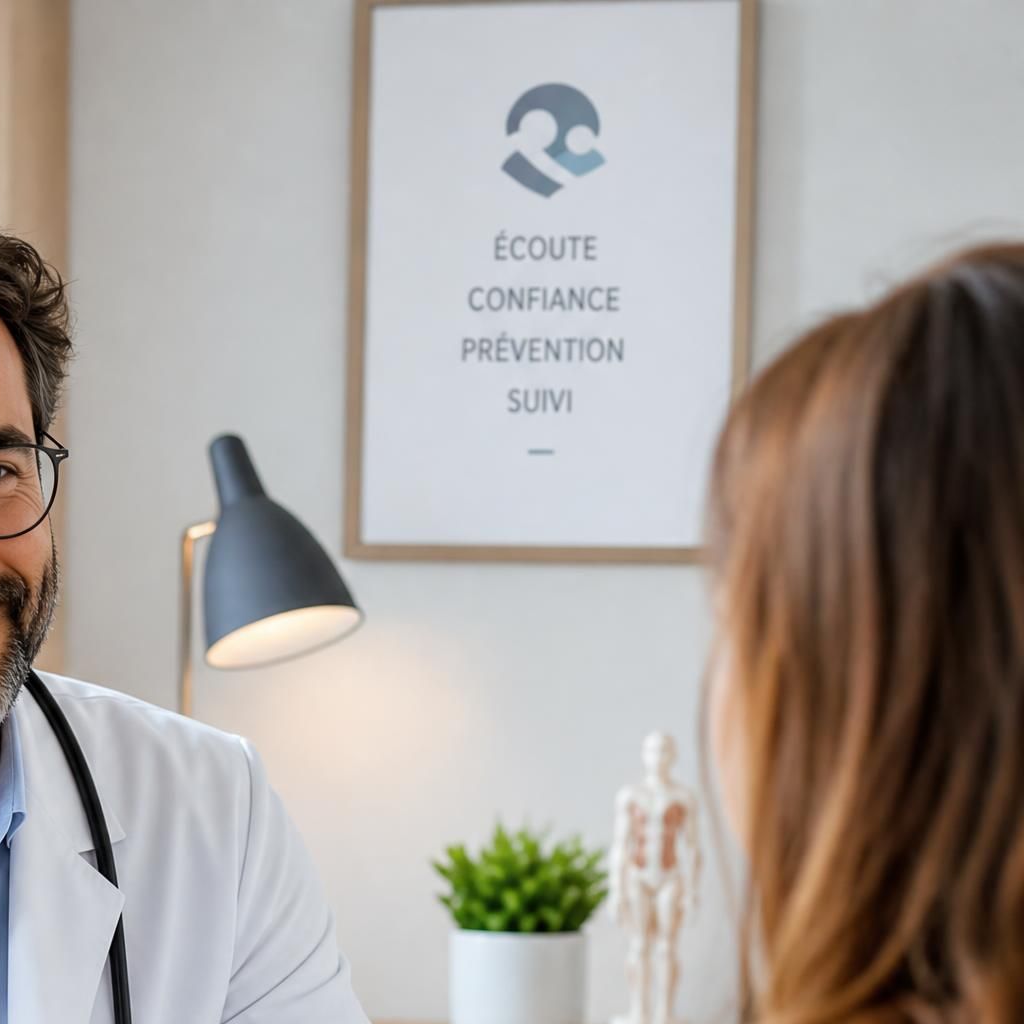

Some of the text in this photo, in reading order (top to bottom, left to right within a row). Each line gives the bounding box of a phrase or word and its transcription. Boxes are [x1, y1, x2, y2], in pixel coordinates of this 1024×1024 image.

[494, 229, 597, 262] ÉCOUTE
[468, 286, 620, 313] CONFIANCE
[461, 332, 625, 363] PRÉVENTION
[507, 388, 573, 414] SUIVI
